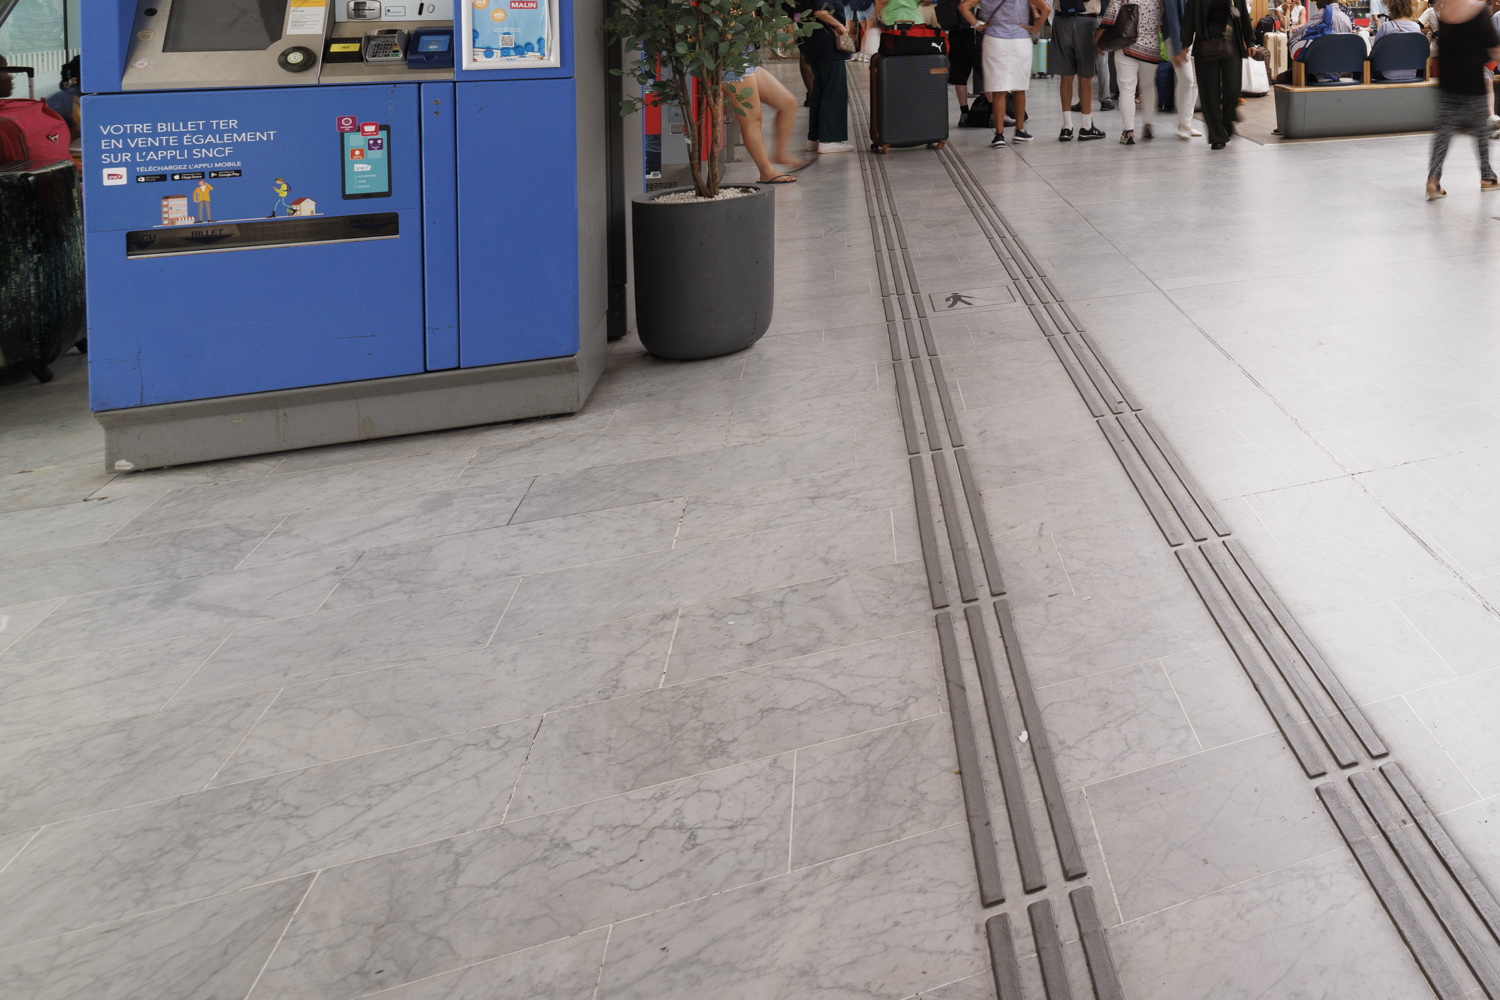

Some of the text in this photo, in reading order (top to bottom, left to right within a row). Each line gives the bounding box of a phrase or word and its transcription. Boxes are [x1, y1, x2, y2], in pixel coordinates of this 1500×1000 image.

[100, 120, 238, 135] VOTRE BILLET TER
[102, 131, 276, 149] EN VENTE ÉGALEMENT
[102, 147, 233, 164] SUR L'APPLI SNCF
[136, 164, 187, 172] TÉLÉCHARGEZ
[191, 228, 224, 238] BILLET
